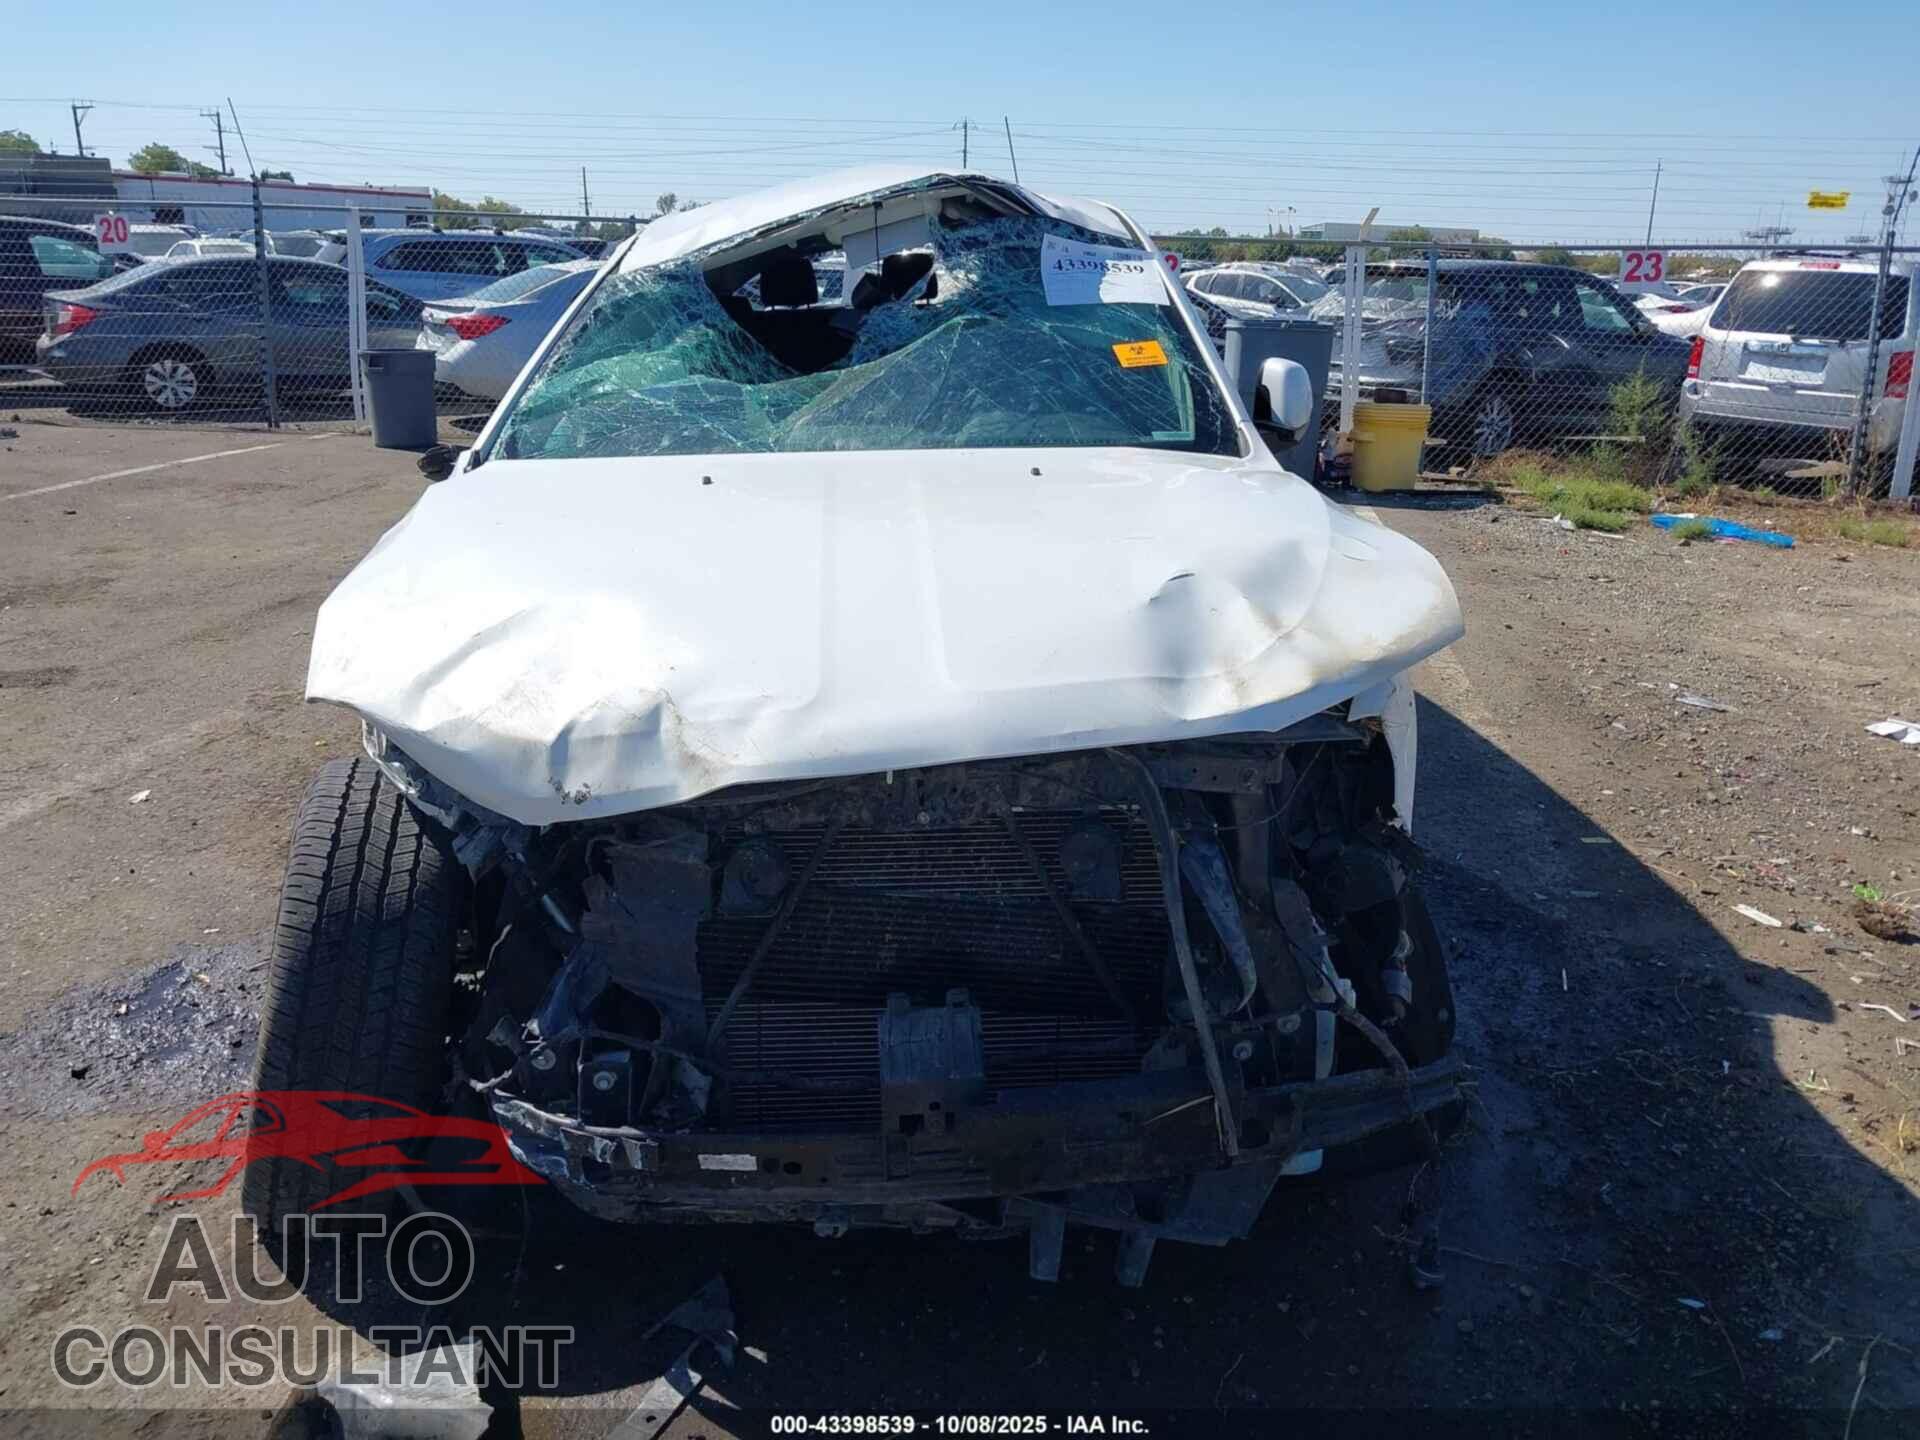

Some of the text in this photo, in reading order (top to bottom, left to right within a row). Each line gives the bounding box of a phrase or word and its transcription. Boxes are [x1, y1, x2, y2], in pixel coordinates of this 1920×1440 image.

[99, 217, 128, 243] 20
[1053, 258, 1145, 274] 43398539
[1624, 252, 1663, 282] 23
